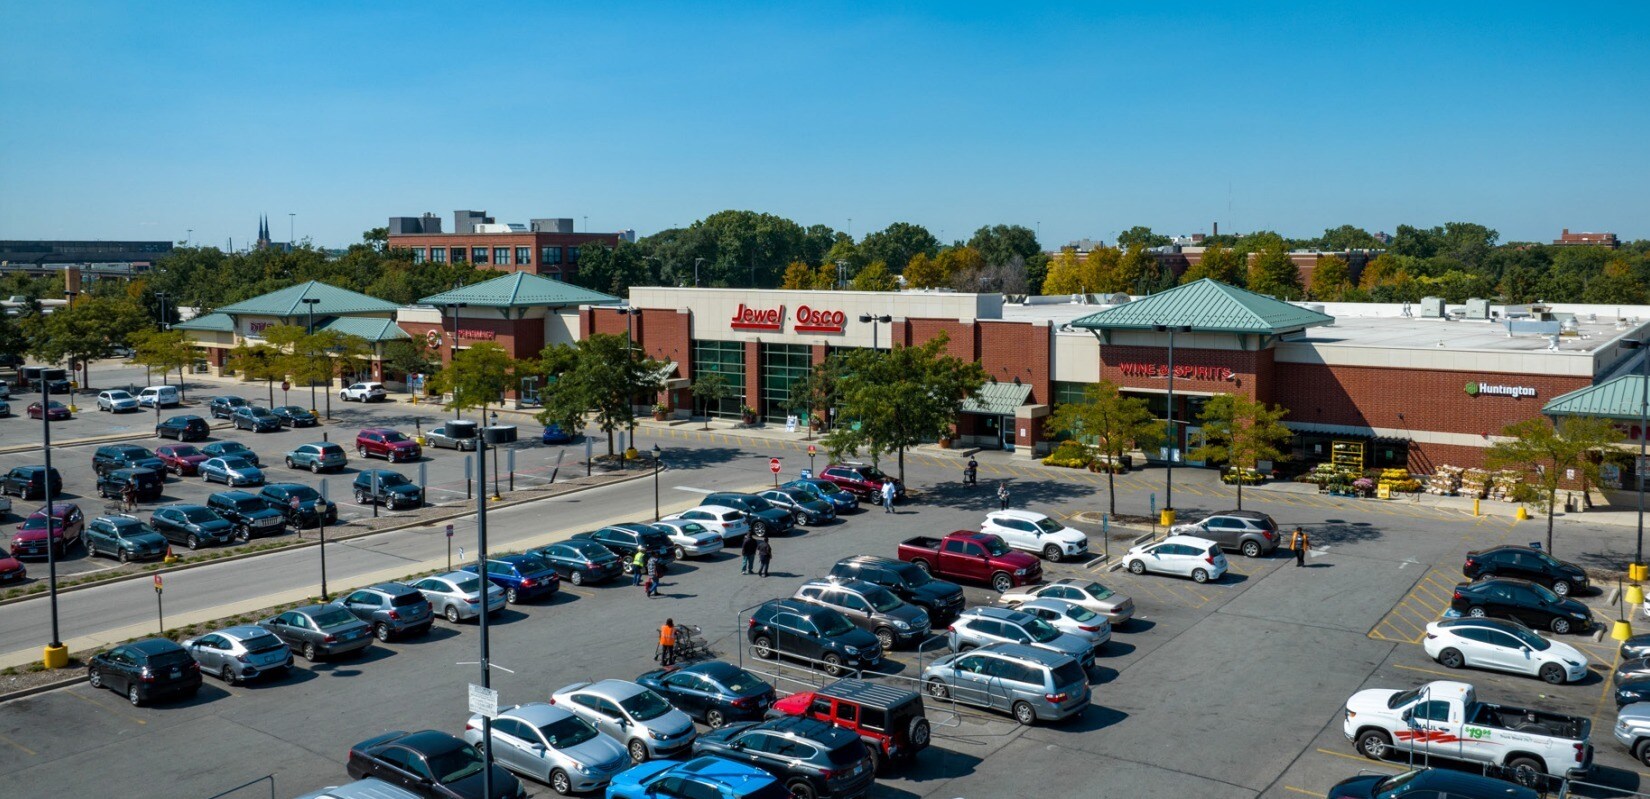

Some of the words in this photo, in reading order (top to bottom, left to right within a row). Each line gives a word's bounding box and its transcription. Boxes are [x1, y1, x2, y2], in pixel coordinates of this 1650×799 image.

[731, 303, 784, 323] Jewel
[796, 304, 845, 326] Osco
[1120, 362, 1156, 374] WINE
[1160, 365, 1169, 375] &
[1174, 365, 1231, 378] SPIRITS
[1479, 383, 1535, 397] Huntington
